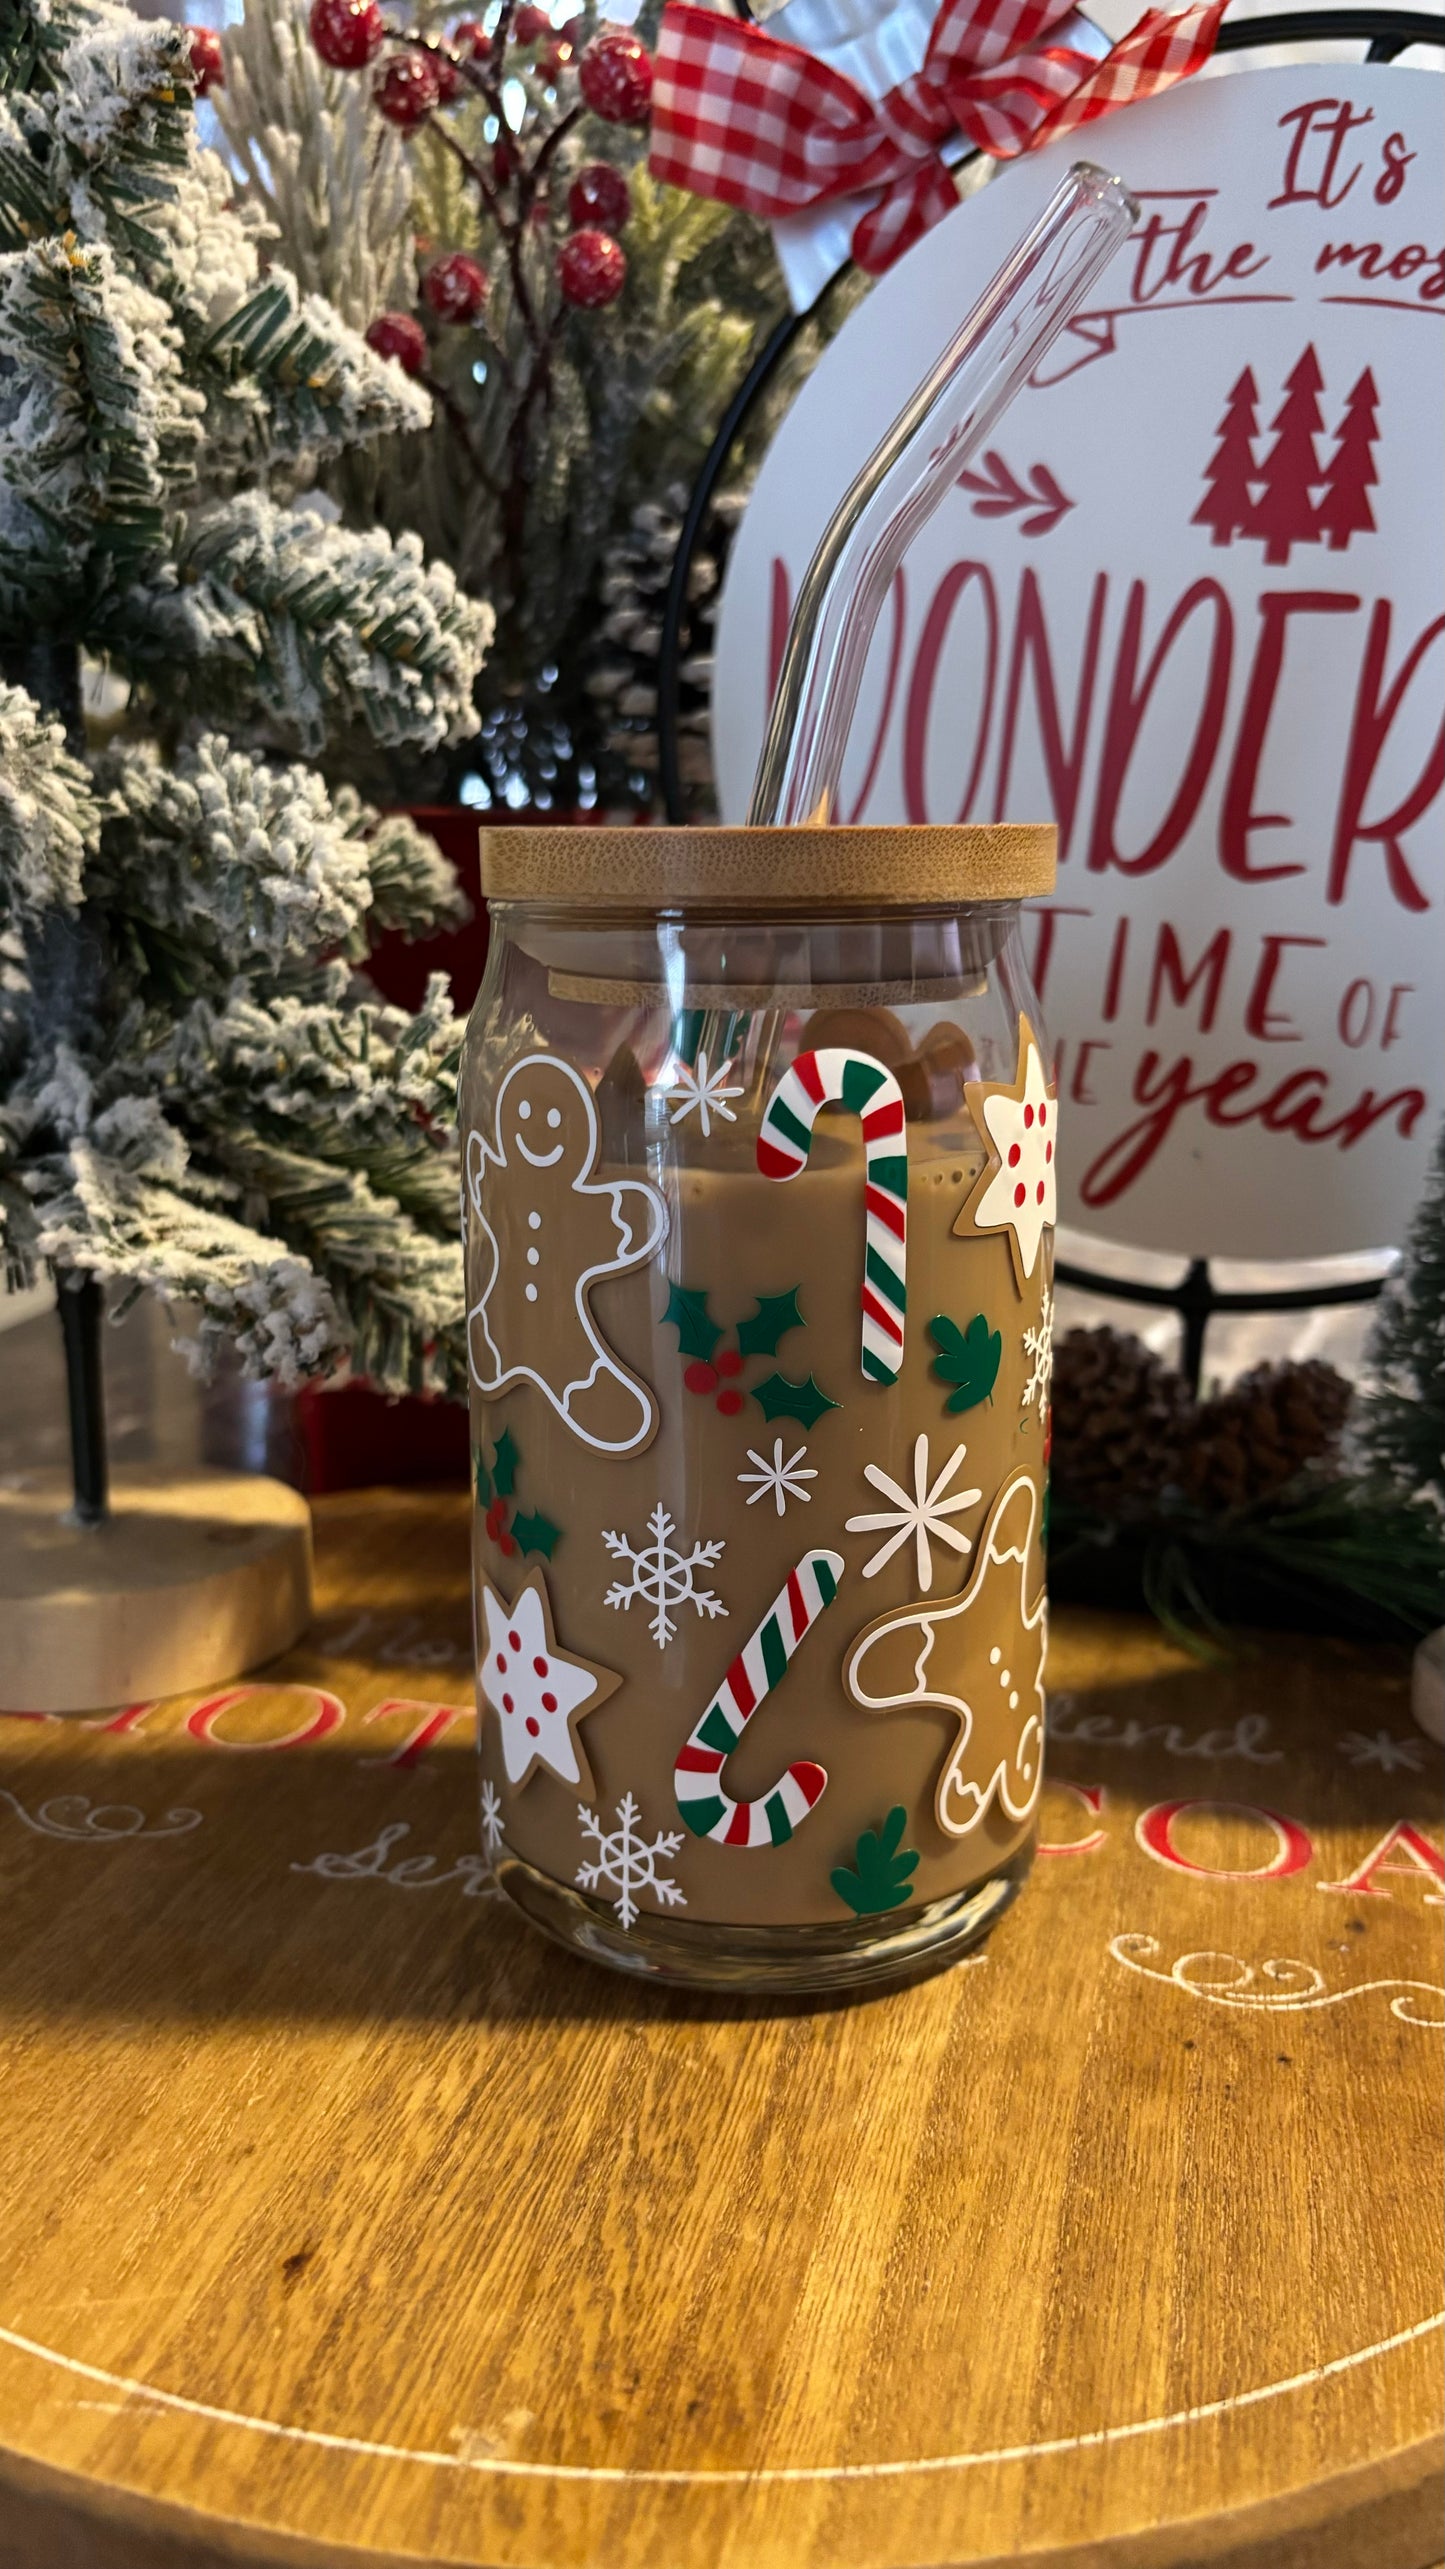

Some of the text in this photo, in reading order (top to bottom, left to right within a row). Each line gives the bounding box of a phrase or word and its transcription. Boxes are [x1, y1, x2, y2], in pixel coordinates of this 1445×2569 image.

[1266, 98, 1418, 210] It's
[1126, 200, 1272, 304] the
[1018, 904, 1417, 1052] TIME OF
[1078, 1050, 1427, 1211] year
[1045, 1688, 1284, 1763] lend
[288, 1822, 500, 1898] Ser
